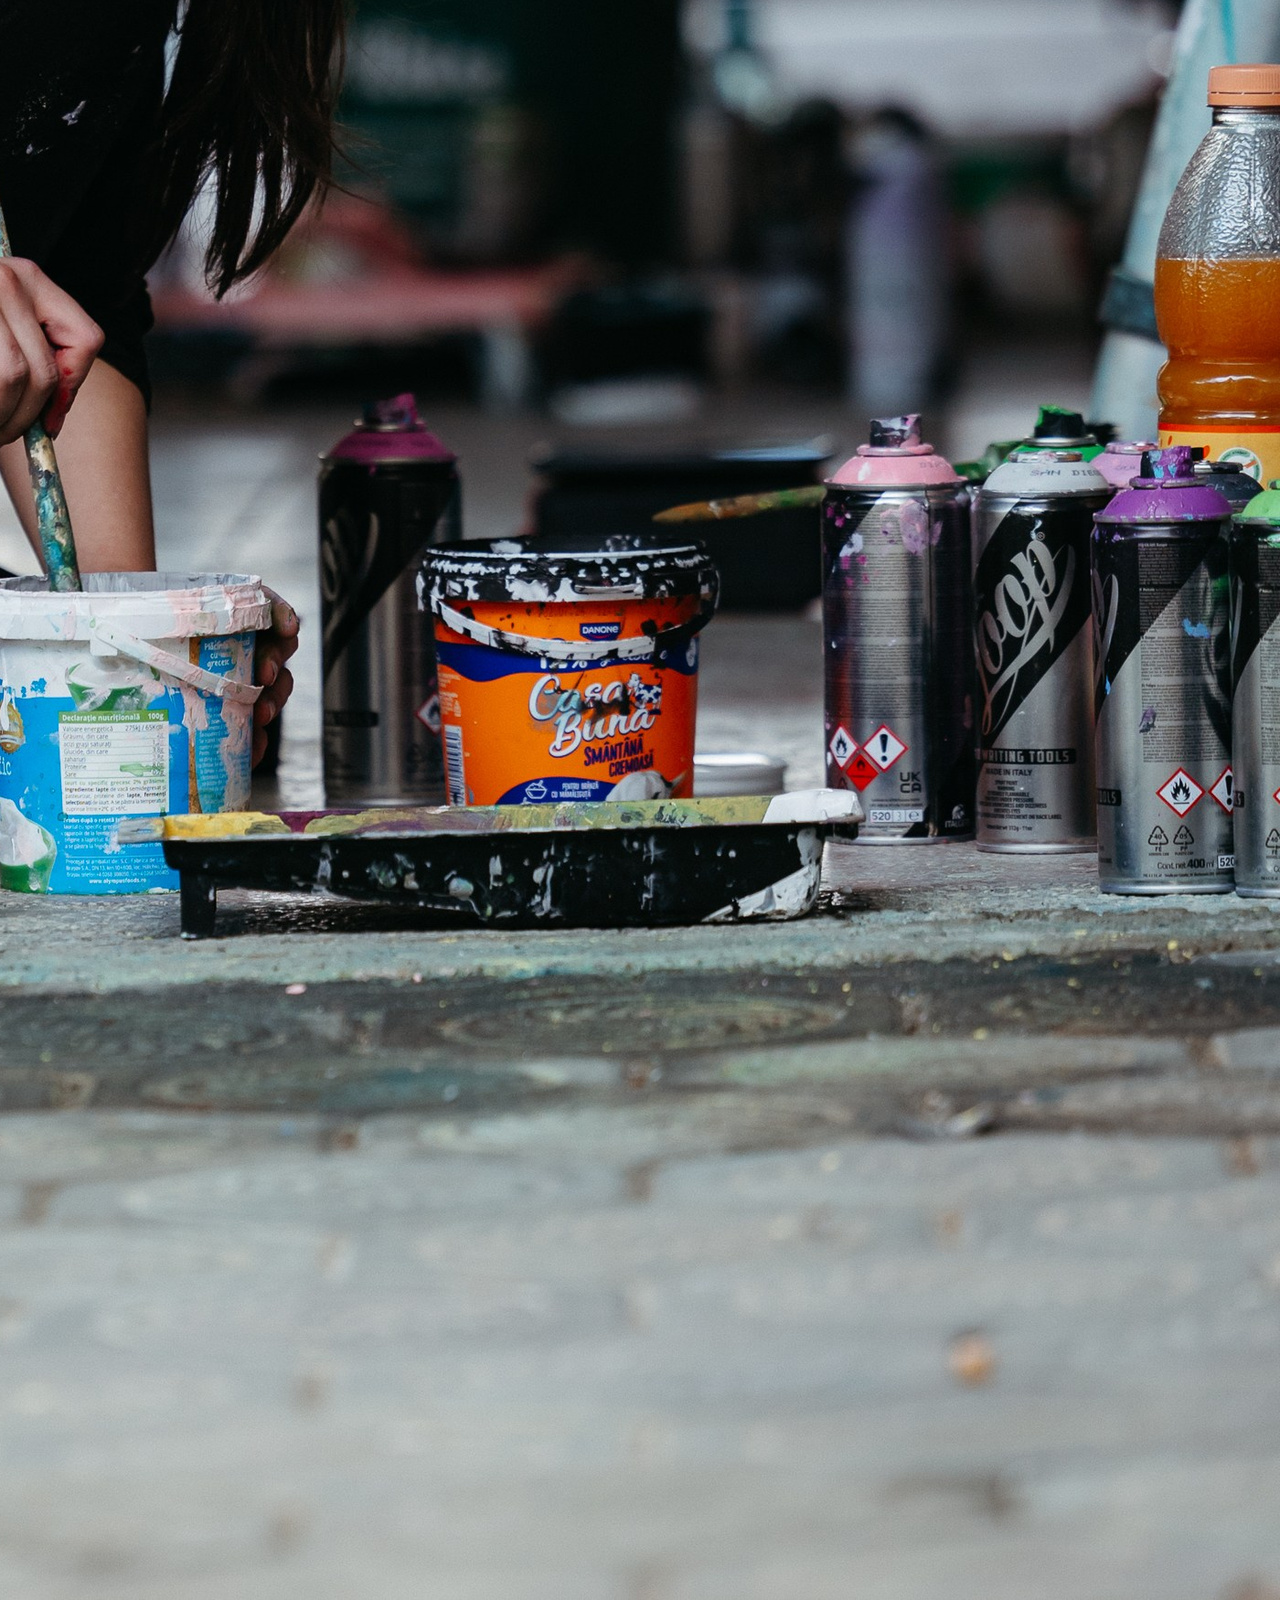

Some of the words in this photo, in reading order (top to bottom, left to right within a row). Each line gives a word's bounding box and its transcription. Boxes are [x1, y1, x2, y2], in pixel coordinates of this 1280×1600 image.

[1030, 469, 1061, 477] SAN
[147, 712, 164, 721] 100g
[1028, 750, 1070, 763] TOOLS
[899, 771, 921, 782] UK
[1011, 769, 1033, 777] ITALY
[899, 783, 922, 794] CA
[871, 811, 891, 821] 520
[1187, 858, 1205, 869] 400
[1219, 857, 1235, 867] 520
